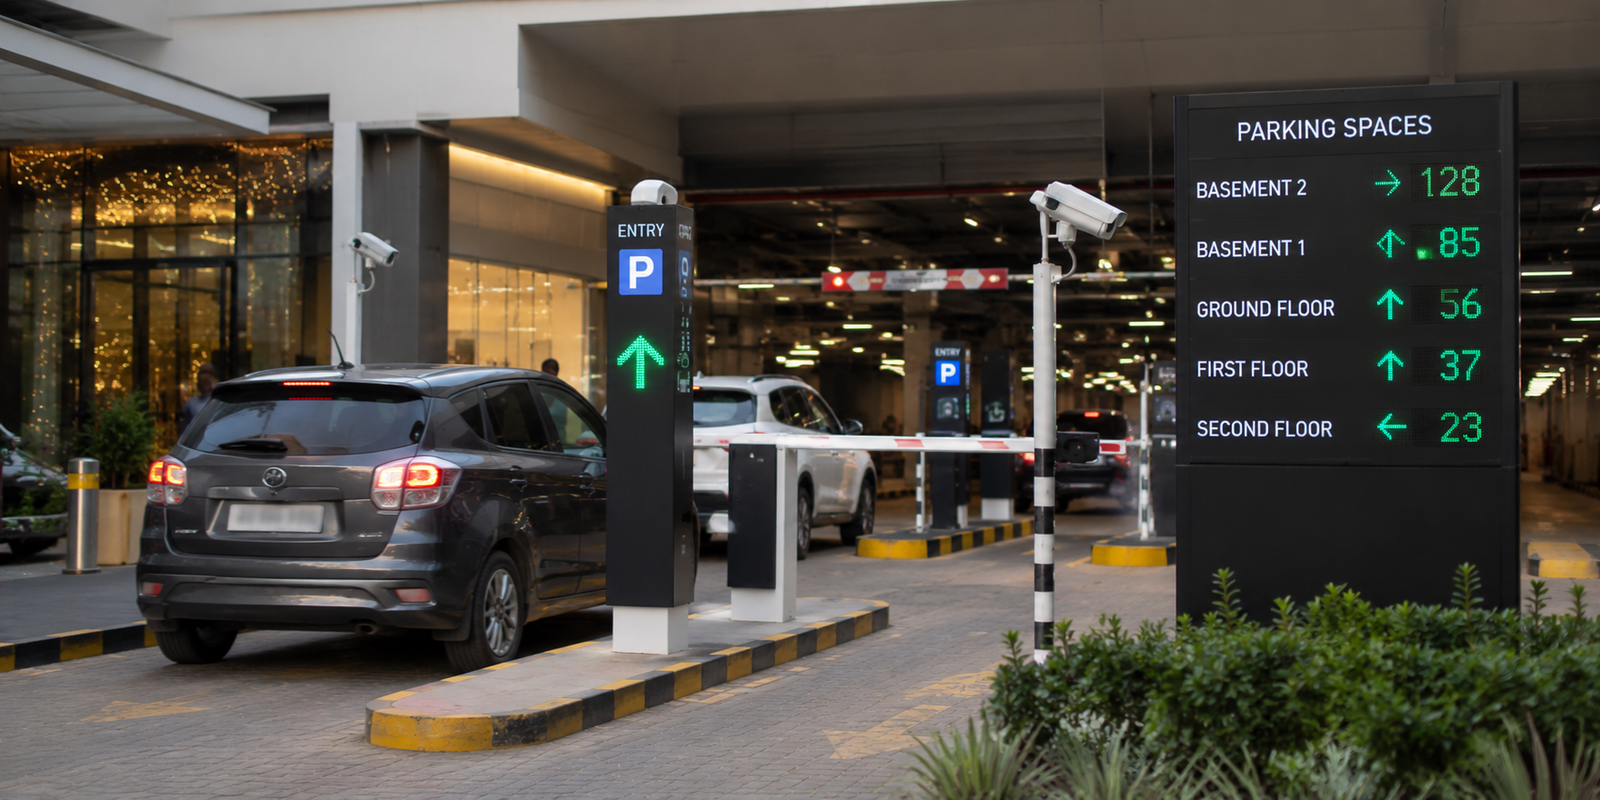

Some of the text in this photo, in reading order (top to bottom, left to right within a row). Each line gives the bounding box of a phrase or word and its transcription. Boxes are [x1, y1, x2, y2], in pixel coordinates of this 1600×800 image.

[1237, 115, 1433, 142] PARKING SPACES
[1196, 179, 1307, 199] BASEMENT 2
[1421, 165, 1481, 198] 128
[617, 223, 665, 238] ENTRY
[1196, 239, 1306, 258] BASEMENT 1
[1438, 226, 1481, 258] 85
[629, 256, 655, 289] P
[1196, 299, 1335, 319] GROUND FLOOR
[1439, 288, 1482, 320] 56
[934, 347, 961, 358] ENTRY
[940, 363, 957, 384] P
[1196, 360, 1247, 378] FIRST
[1250, 360, 1309, 378] FLOOR
[1439, 349, 1482, 382] 37
[1196, 420, 1333, 438] SECOND FLOOR
[1440, 411, 1483, 443] 23
